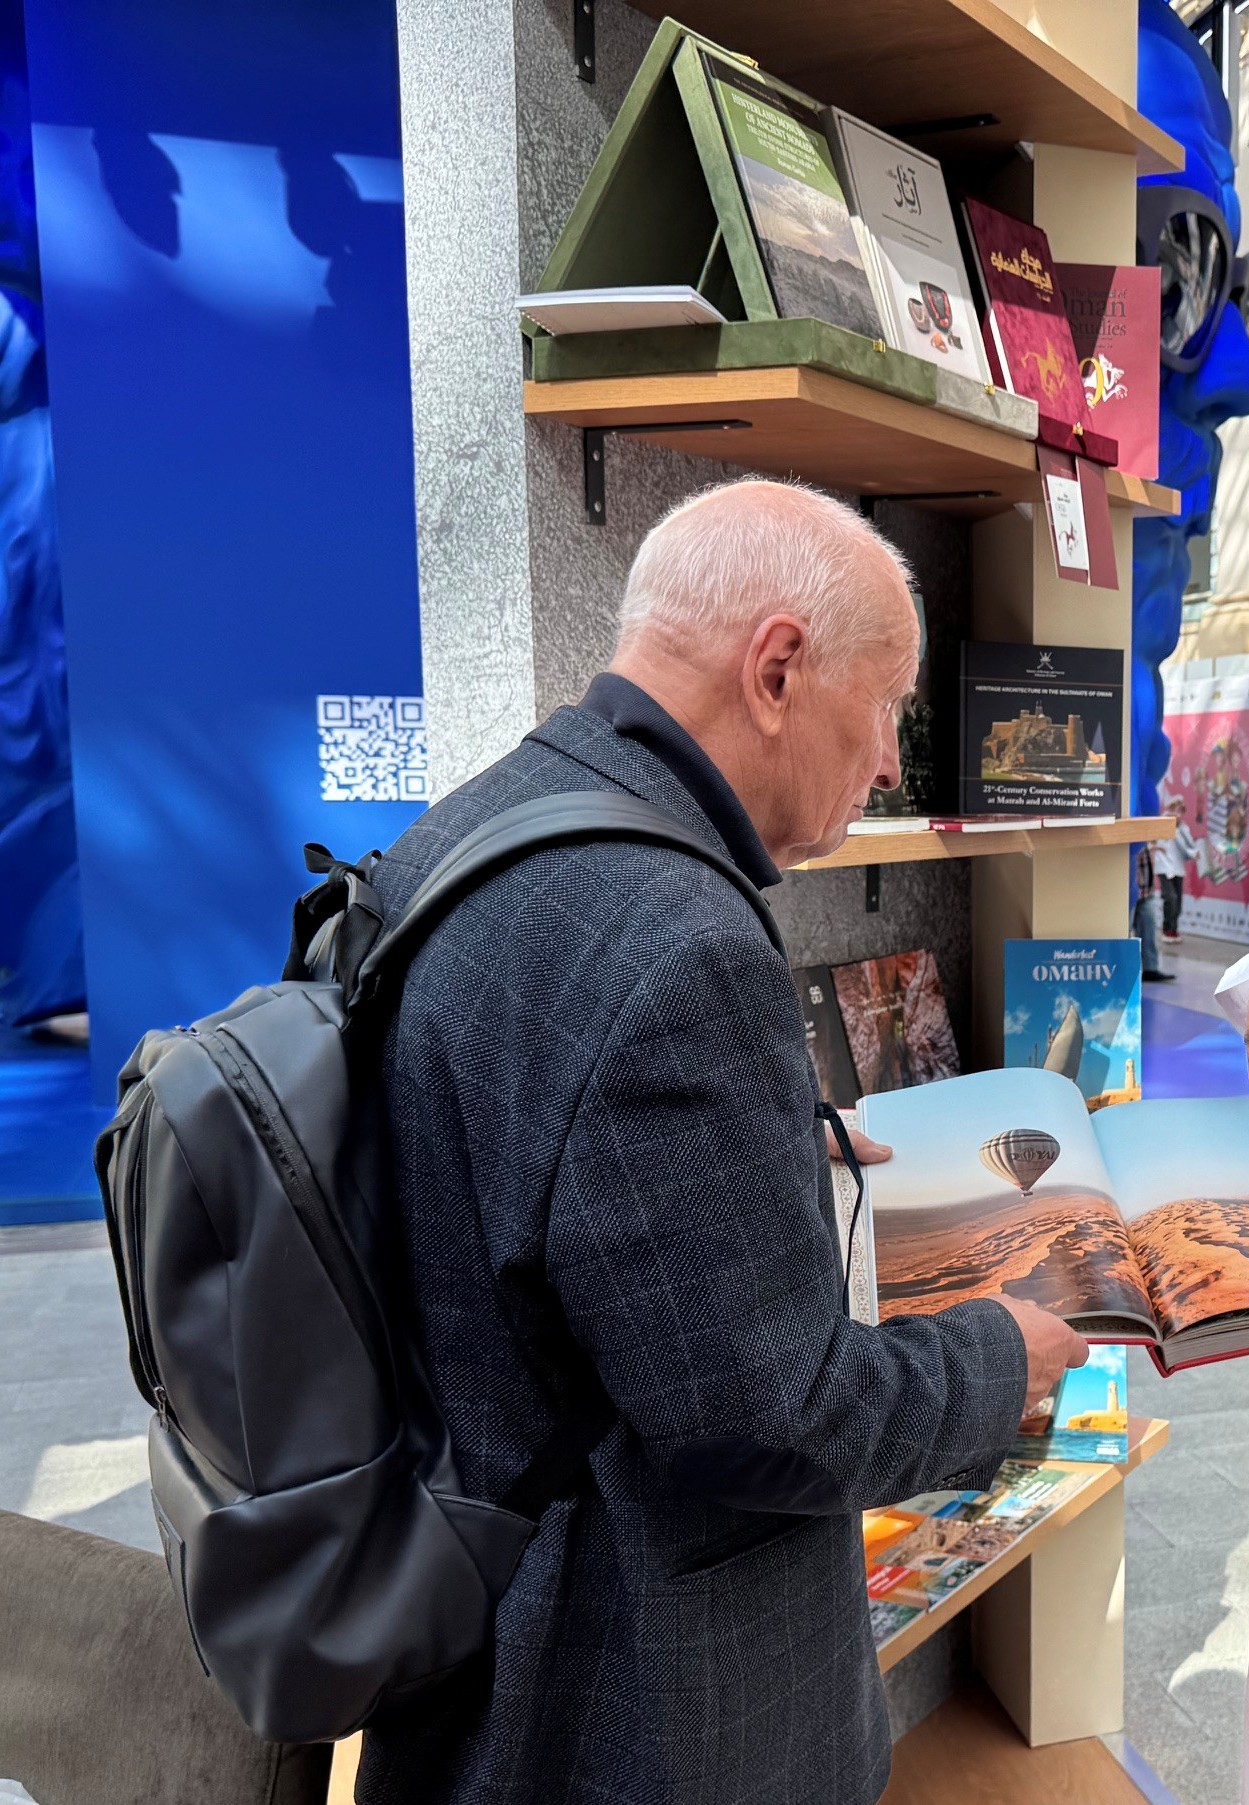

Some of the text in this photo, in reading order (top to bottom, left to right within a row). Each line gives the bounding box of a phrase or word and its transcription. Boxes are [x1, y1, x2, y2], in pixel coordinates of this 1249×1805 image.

[975, 685, 1001, 693] HERITAGE
[1001, 686, 1041, 695] ARCHITECTURE
[1029, 786, 1079, 797] Conservation
[1079, 788, 1104, 797] Works
[1026, 797, 1041, 806] and
[1079, 798, 1100, 808] Forts
